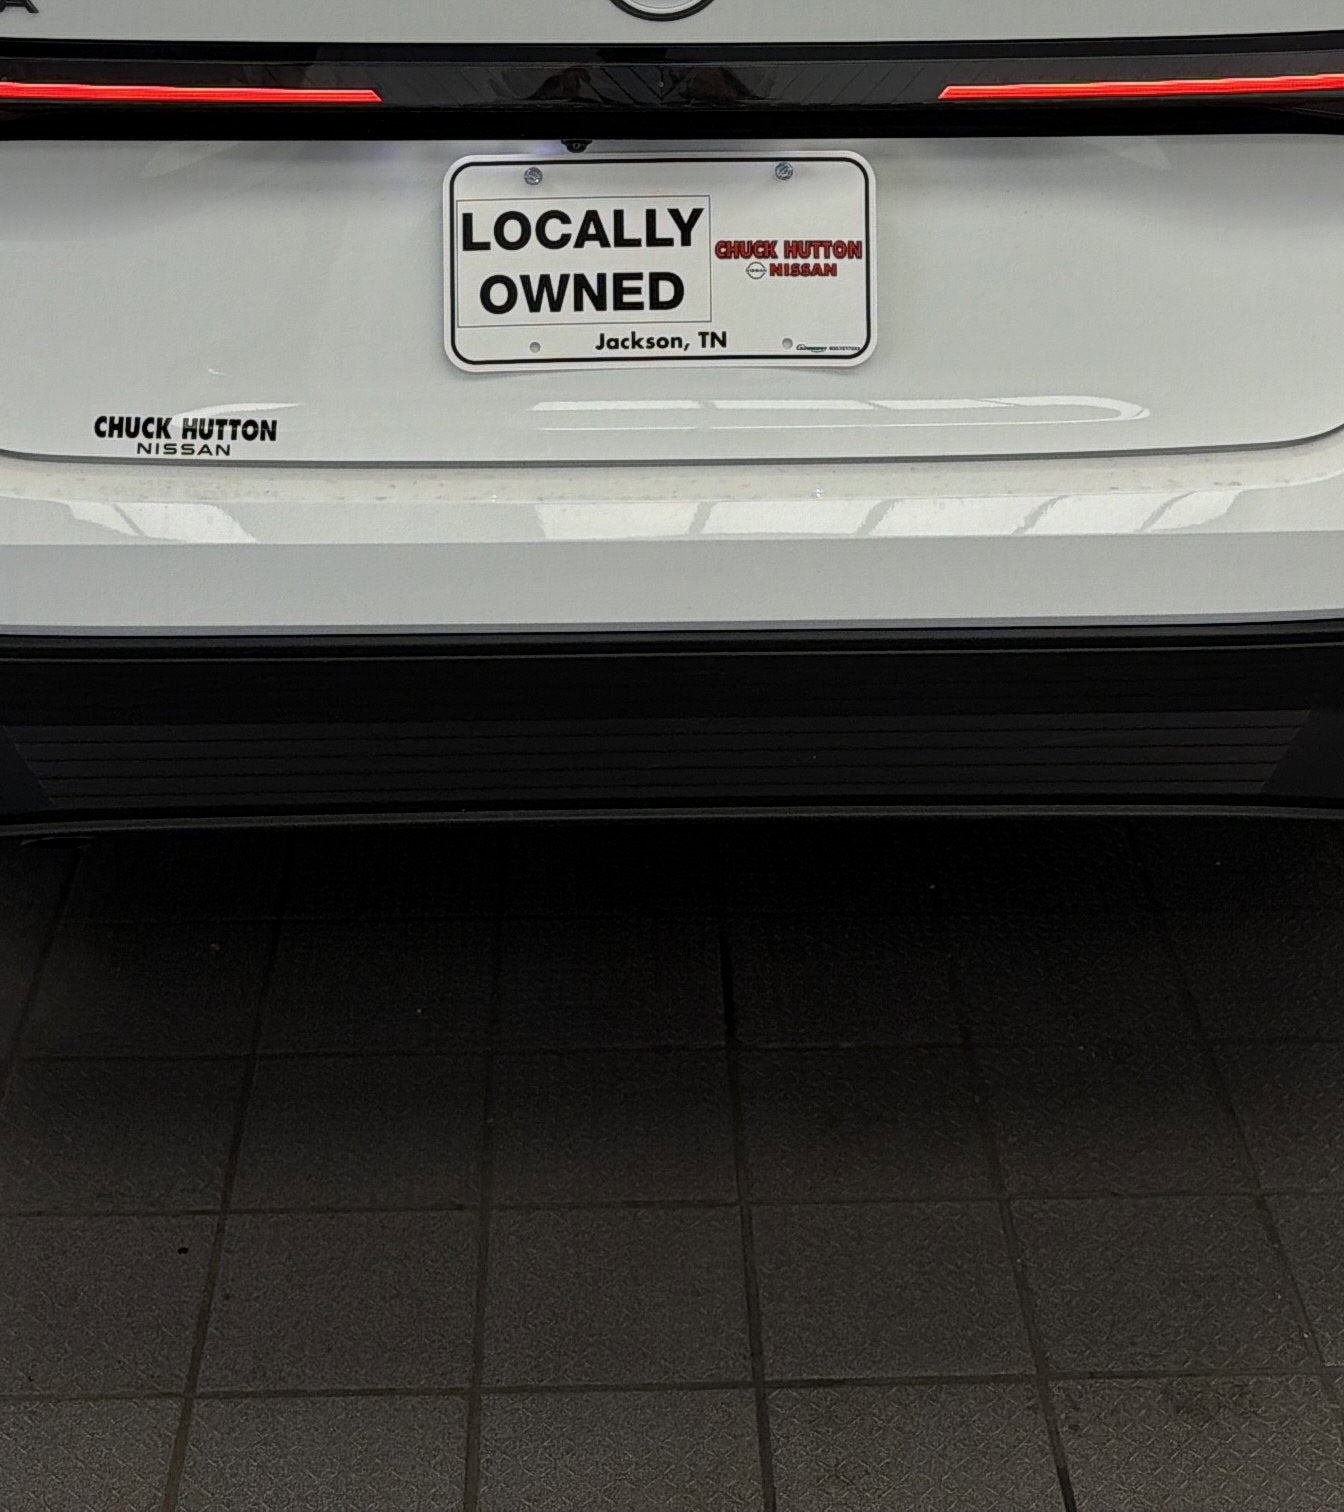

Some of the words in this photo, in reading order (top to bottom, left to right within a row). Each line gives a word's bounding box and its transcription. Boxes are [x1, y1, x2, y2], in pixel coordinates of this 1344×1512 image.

[462, 207, 704, 251] LOCALLY
[714, 240, 778, 259] CHUCK
[783, 240, 863, 259] HUTTON
[769, 263, 838, 277] NISSAN
[479, 271, 685, 314] OWNED
[595, 332, 689, 351] Jackson,
[698, 331, 727, 348] TN
[94, 416, 172, 438] CHUCK
[182, 418, 277, 441] HUTTON
[137, 443, 231, 456] NISSAN
